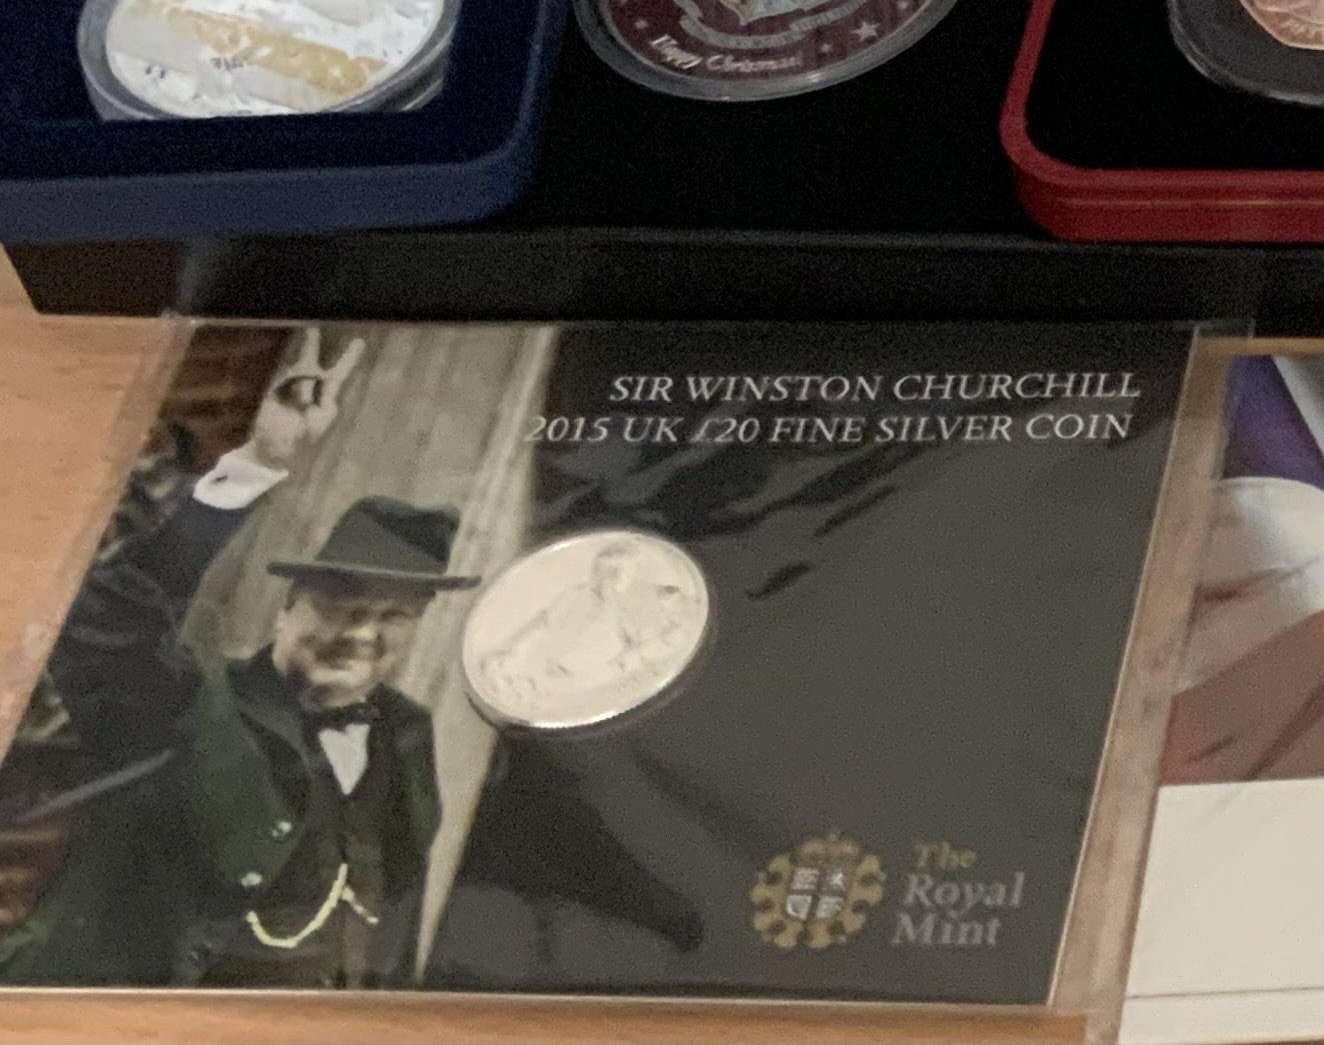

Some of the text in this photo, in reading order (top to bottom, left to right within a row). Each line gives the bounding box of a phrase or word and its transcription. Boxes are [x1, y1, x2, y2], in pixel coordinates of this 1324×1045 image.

[608, 371, 1143, 404] SIR WINSTON CHURCHILL
[523, 412, 1134, 444] 2015 UK £20 FINE SILVER COIN
[913, 840, 978, 870] The
[904, 870, 1026, 920] Royal
[890, 912, 1002, 947] Mint
